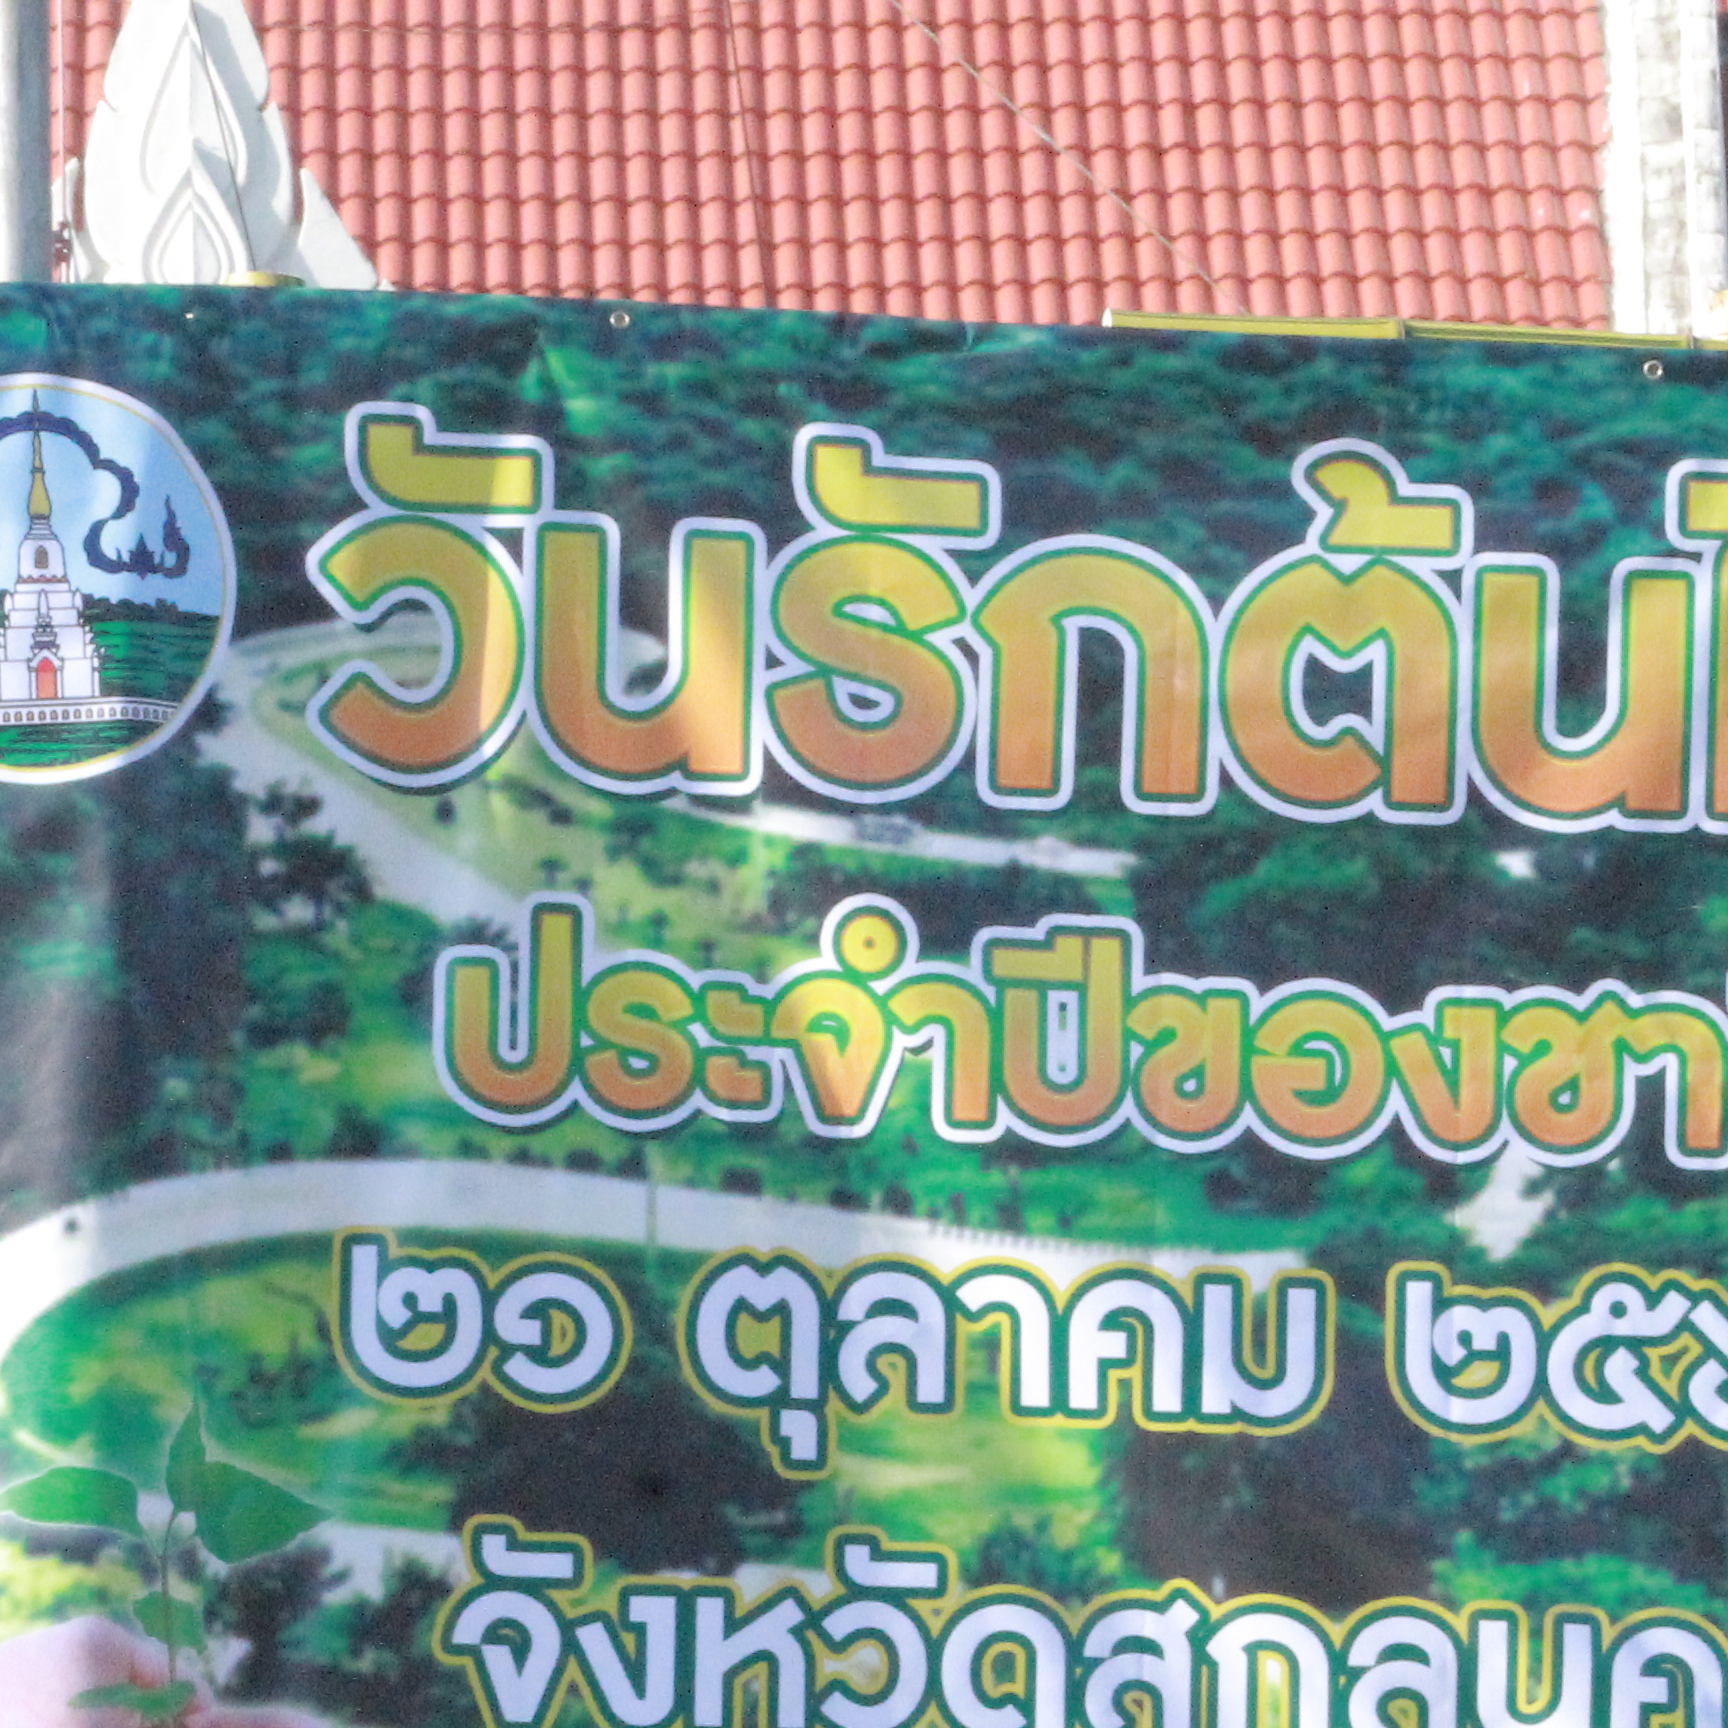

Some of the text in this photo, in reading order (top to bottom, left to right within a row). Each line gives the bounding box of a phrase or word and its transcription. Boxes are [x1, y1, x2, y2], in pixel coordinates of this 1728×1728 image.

[342, 1235, 637, 1420] ๒๑
[687, 1252, 1327, 1480] ตุลาคม
